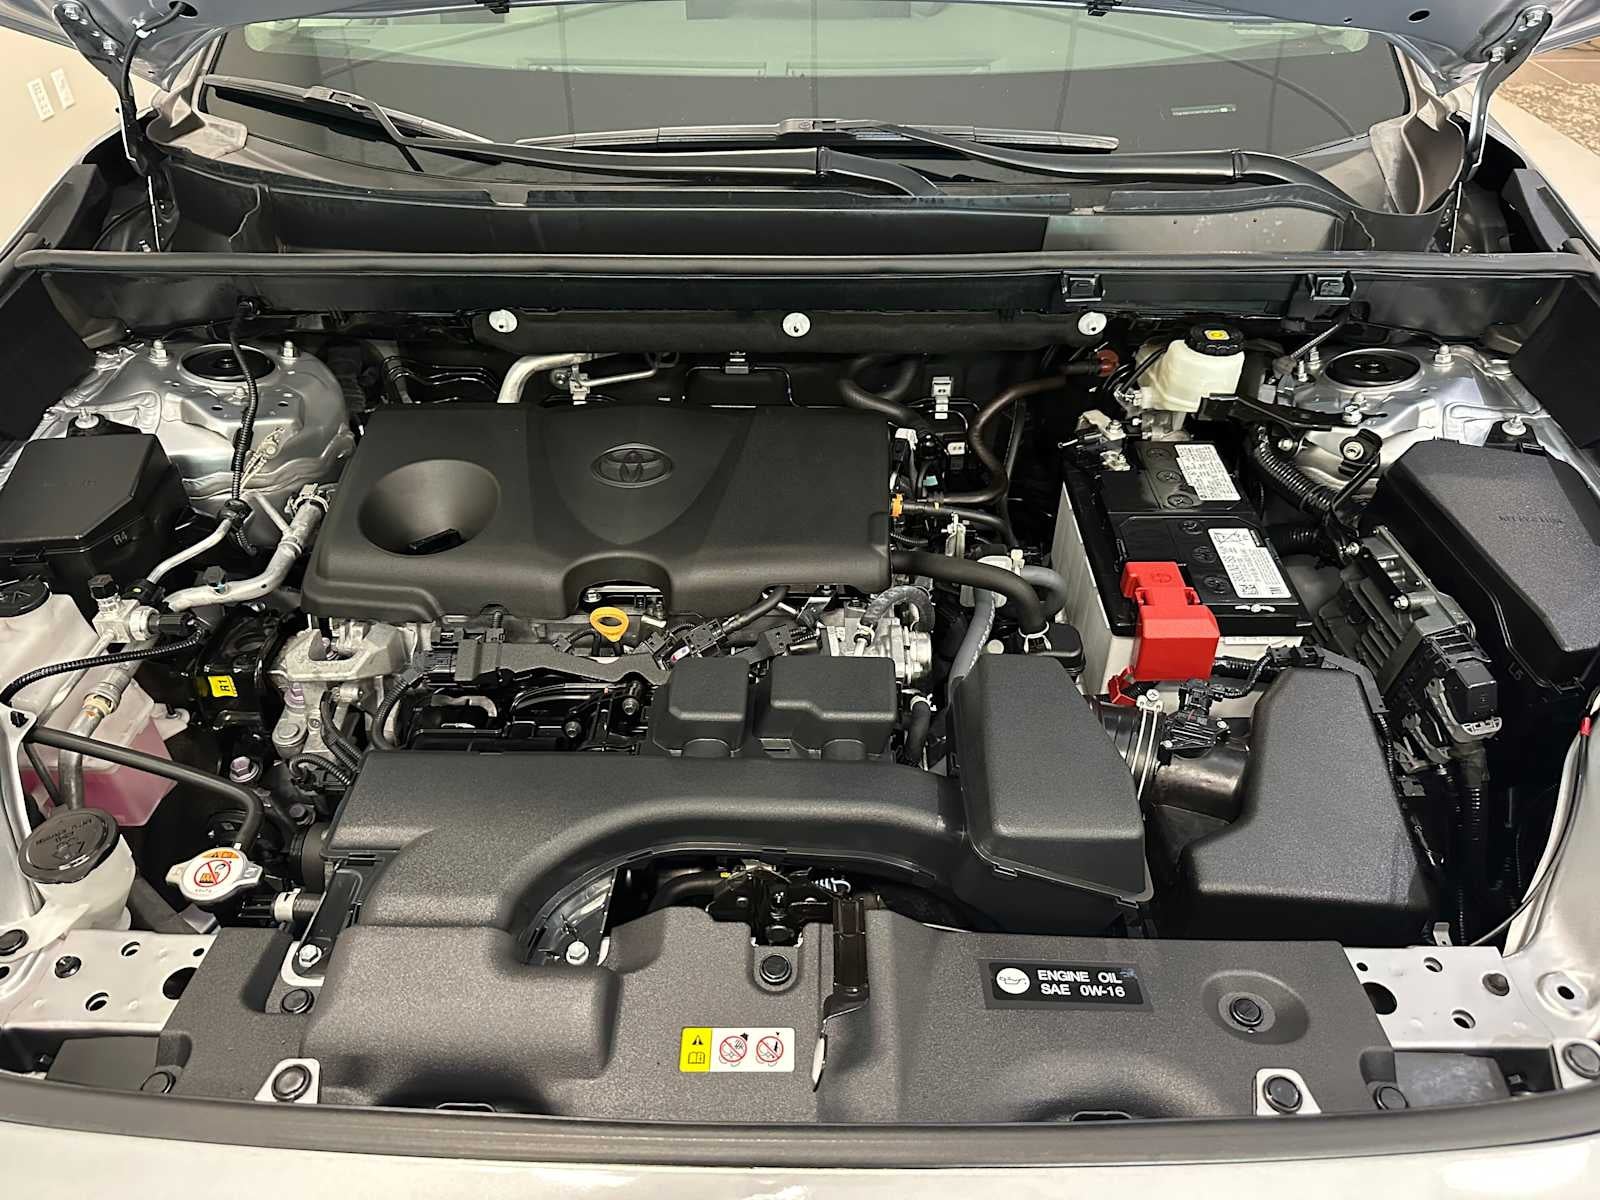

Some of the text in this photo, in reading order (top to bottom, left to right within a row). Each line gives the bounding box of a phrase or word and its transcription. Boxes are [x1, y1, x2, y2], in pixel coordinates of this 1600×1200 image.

[1037, 969, 1123, 984] ENGINE OIL
[1040, 983, 1126, 998] SAE 0W-16
